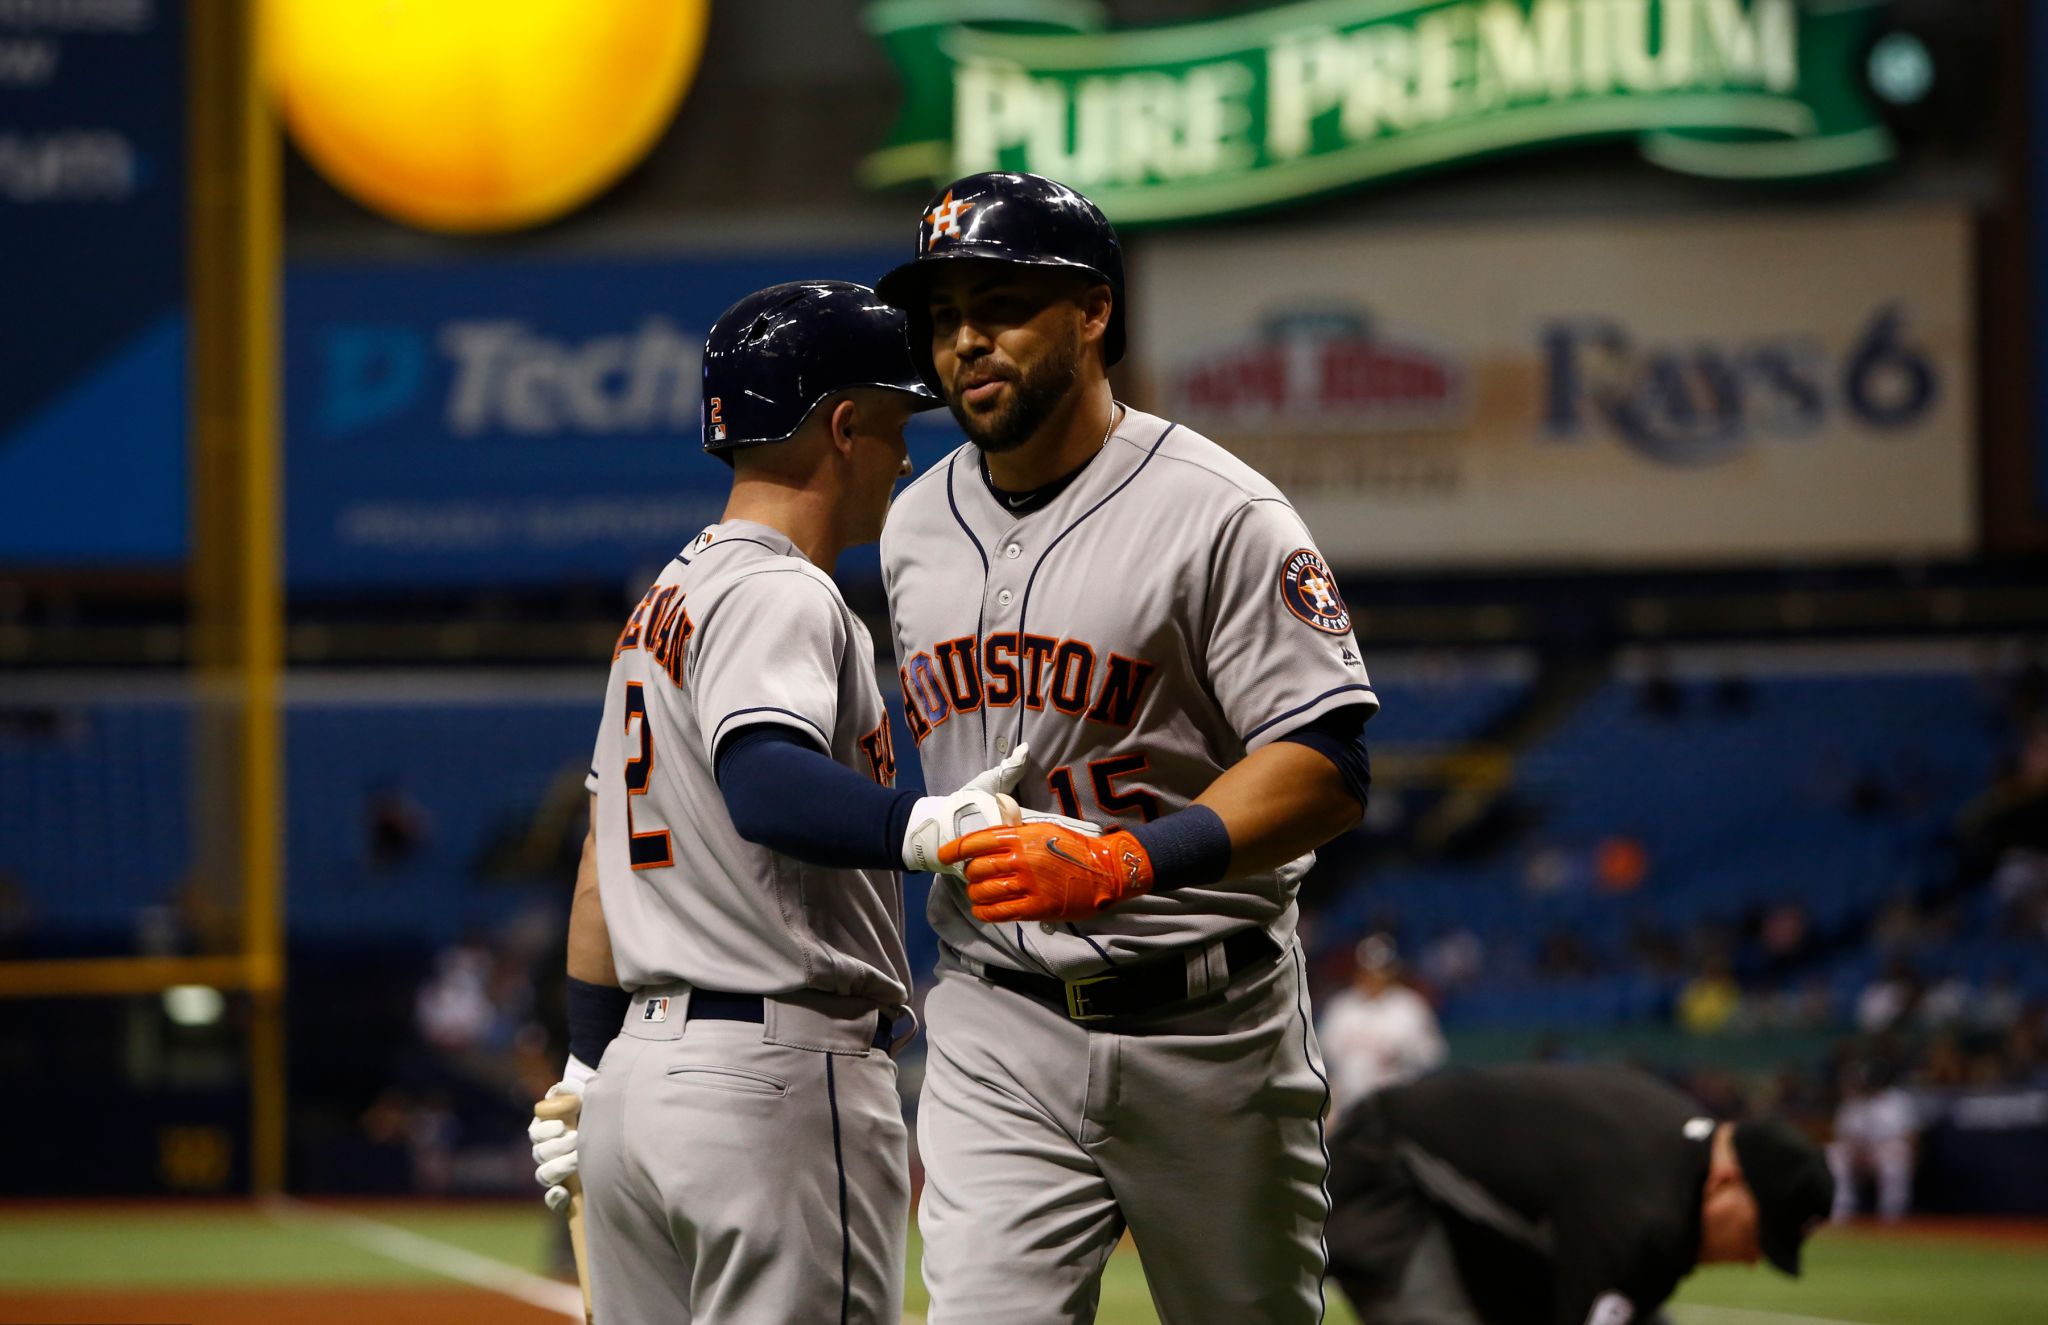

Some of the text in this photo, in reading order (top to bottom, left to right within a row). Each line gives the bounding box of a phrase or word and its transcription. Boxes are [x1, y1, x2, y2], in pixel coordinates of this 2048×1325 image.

[952, 0, 1798, 188] PURE PREMIUM
[930, 199, 961, 241] H
[438, 318, 704, 438] Tech
[710, 397, 722, 423] 2
[1538, 315, 1828, 470] Rays
[1843, 298, 1938, 436] 6
[1286, 553, 1329, 582] HOUSTON
[1305, 577, 1336, 609] H
[1312, 609, 1349, 630] ASTROS
[900, 632, 1156, 750] HOUSTON
[625, 681, 675, 871] 2
[1046, 752, 1159, 835] 15
